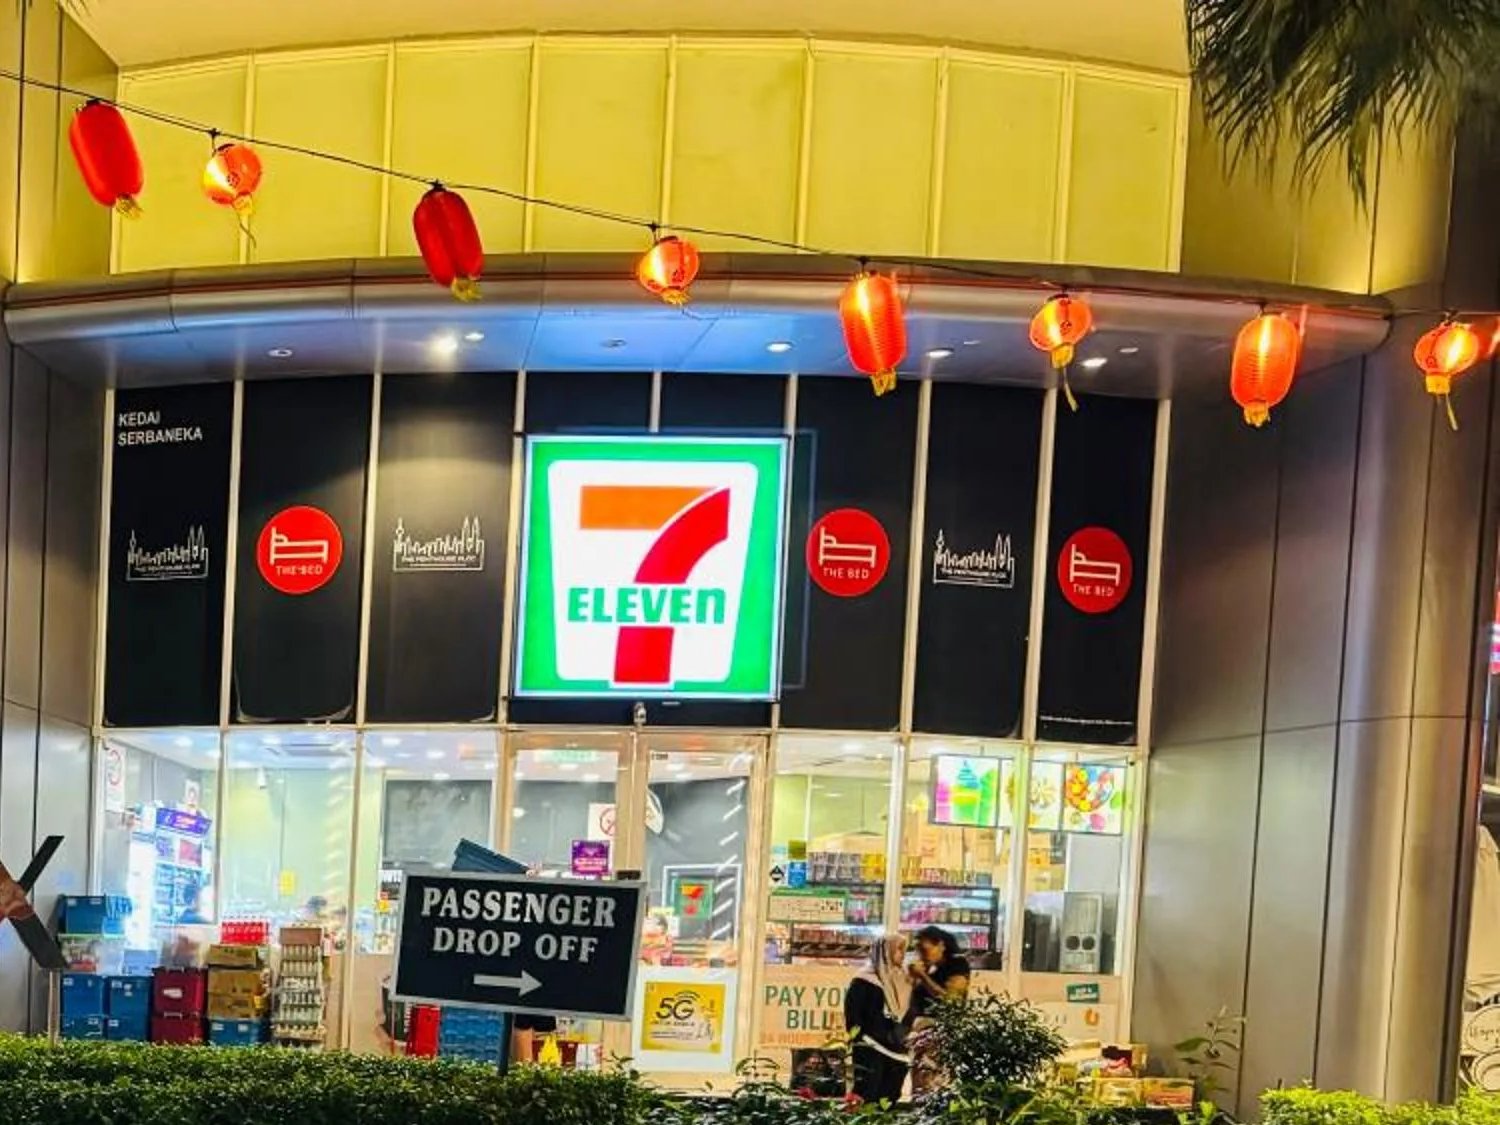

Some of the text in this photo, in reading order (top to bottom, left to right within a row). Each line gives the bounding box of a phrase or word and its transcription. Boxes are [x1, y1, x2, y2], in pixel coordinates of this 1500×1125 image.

[118, 410, 161, 427] KEDAI
[118, 426, 203, 446] SERBANEKA
[275, 564, 297, 577] THE
[822, 566, 870, 580] THE BED
[578, 484, 731, 684] 7
[1072, 583, 1115, 597] THE BED
[420, 886, 618, 928] PASSENGER
[432, 927, 599, 963] DROP OFF
[764, 985, 807, 1007] PAY
[655, 996, 695, 1021] 5G
